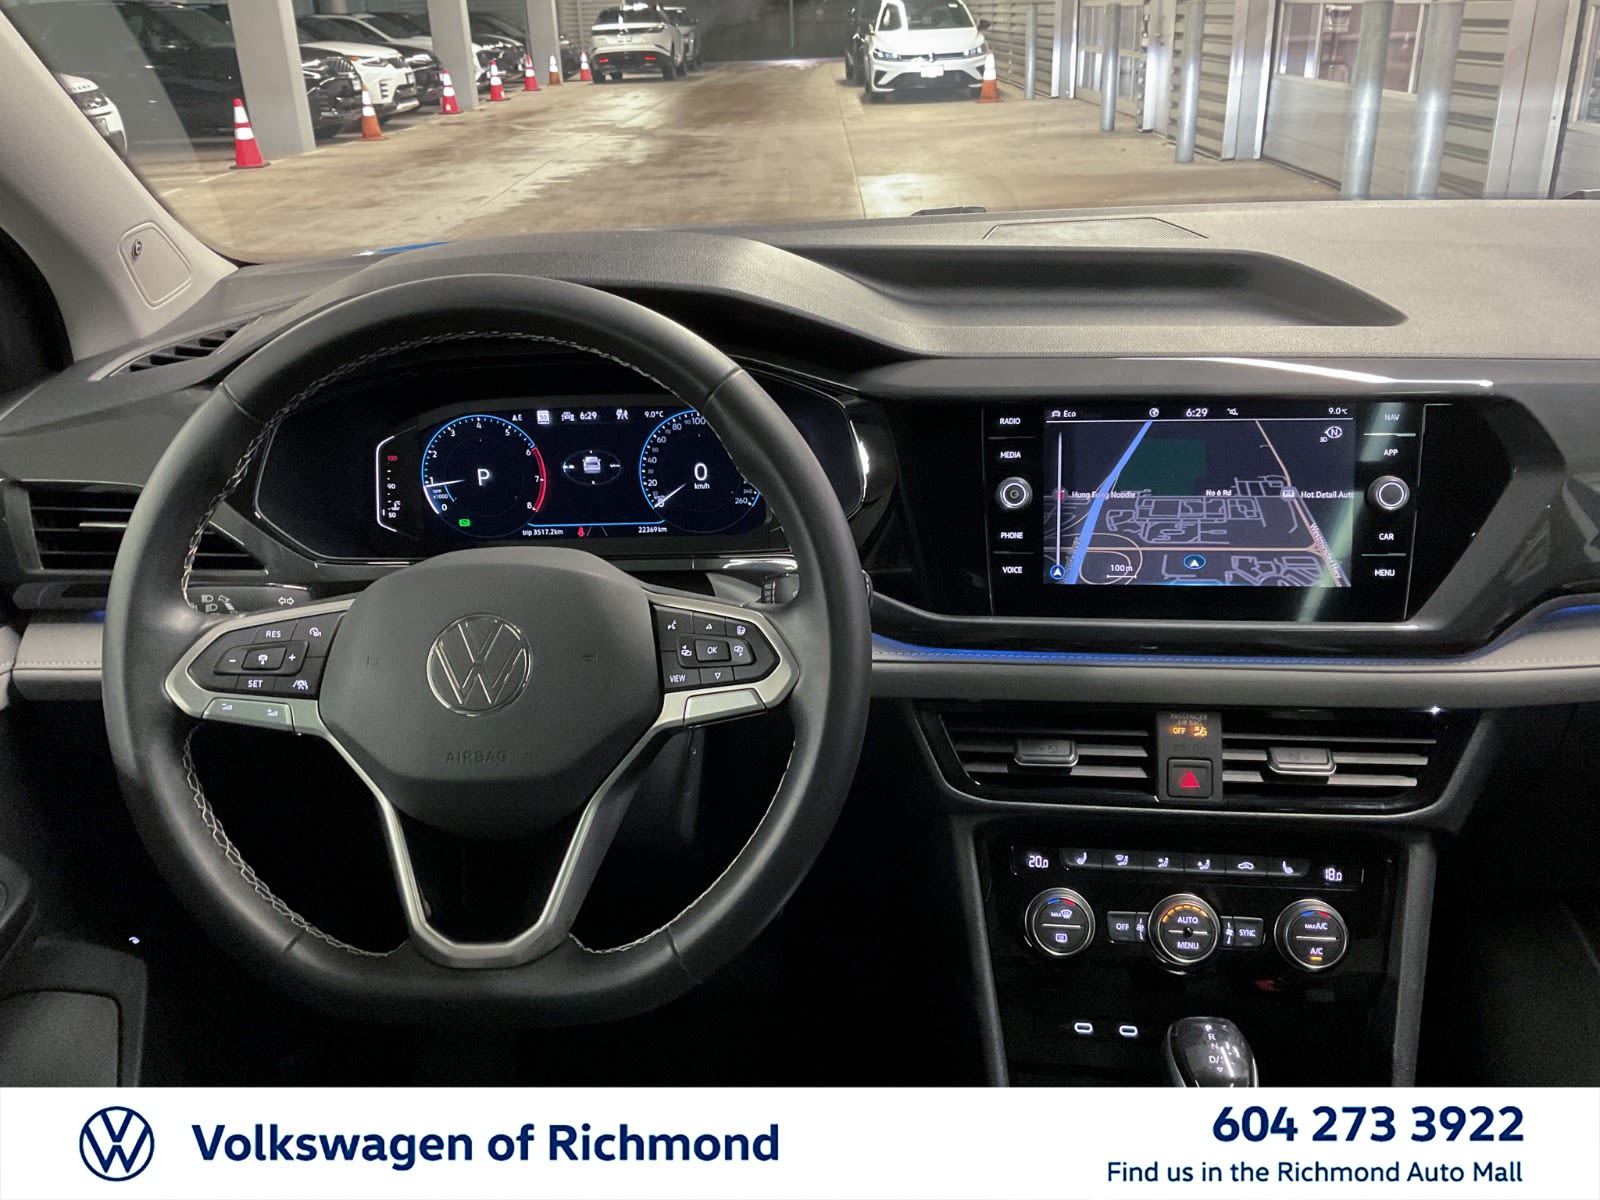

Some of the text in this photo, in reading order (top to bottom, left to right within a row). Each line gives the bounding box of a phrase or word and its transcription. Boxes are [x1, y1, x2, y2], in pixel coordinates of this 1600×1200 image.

[579, 412, 598, 420] 6:29
[1063, 410, 1077, 418] Eco
[1185, 408, 1208, 418] 6:29
[1384, 413, 1400, 421] NAV
[692, 416, 706, 425] 100
[999, 417, 1021, 425] RADIO
[476, 422, 482, 430] 4
[672, 423, 682, 431] 80
[450, 429, 456, 437] 3
[505, 428, 511, 437] 5
[432, 450, 438, 458] 2
[526, 449, 532, 457] 6
[1000, 451, 1021, 459] MEDIA
[1383, 448, 1398, 456] APP
[694, 462, 708, 481] 0
[477, 468, 490, 486] P
[647, 479, 658, 487] 20
[694, 482, 710, 490] km/h
[1205, 489, 1216, 497] No
[1222, 489, 1232, 497] Rd
[1300, 491, 1314, 499] Hot
[1315, 490, 1336, 499] Detail
[735, 497, 748, 505] 260
[441, 504, 448, 512] 0
[388, 511, 397, 519] 50
[522, 529, 532, 537] trip
[1000, 531, 1024, 540] PHONE
[1378, 532, 1394, 541] CAR
[1002, 566, 1023, 574] VOICE
[1110, 564, 1125, 572] 100
[1374, 569, 1396, 577] MENU
[265, 630, 282, 638] RES
[707, 646, 718, 654] OK
[669, 674, 686, 683] VIEW
[247, 679, 263, 688] SET
[1172, 727, 1187, 735] OFF
[446, 752, 508, 764] AIRBAG
[1177, 916, 1199, 925] AUTO
[1115, 922, 1130, 931] OFF
[1238, 929, 1256, 938] SYNC
[1177, 941, 1199, 950] MENU
[1310, 947, 1324, 955] A/C
[1205, 1024, 1213, 1032] P
[1208, 1033, 1216, 1041] R
[1210, 1042, 1219, 1050] N
